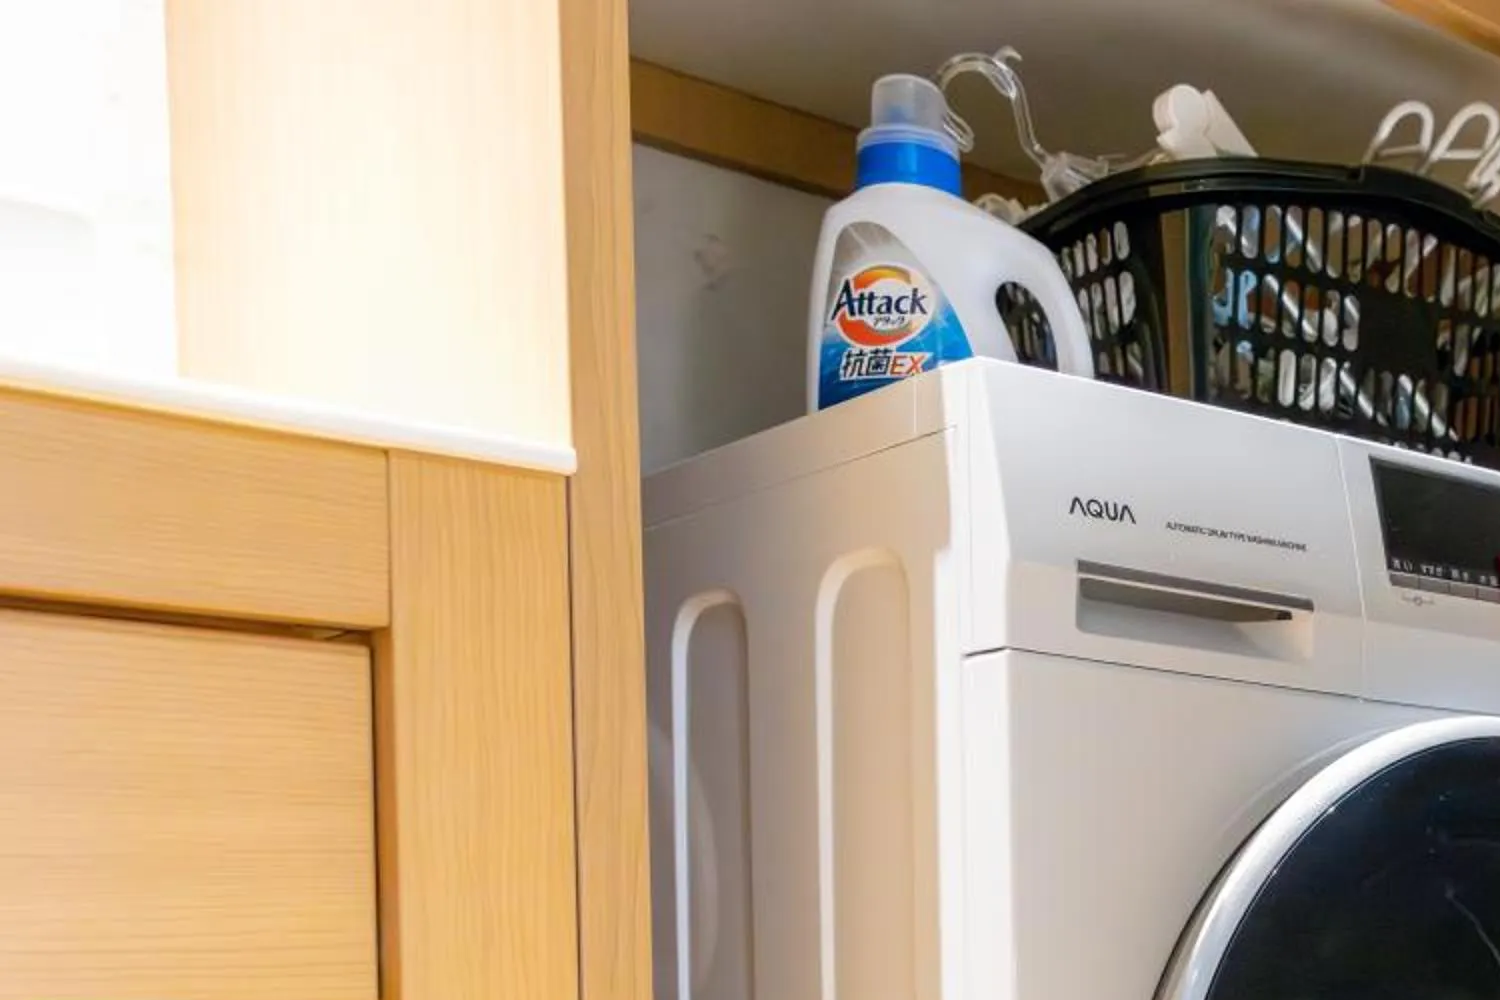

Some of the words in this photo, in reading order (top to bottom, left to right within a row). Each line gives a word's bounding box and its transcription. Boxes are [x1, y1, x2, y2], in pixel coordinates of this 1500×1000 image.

[831, 279, 928, 321] Attack
[843, 347, 925, 378] 抗菌EX
[1069, 496, 1137, 524] AQUA
